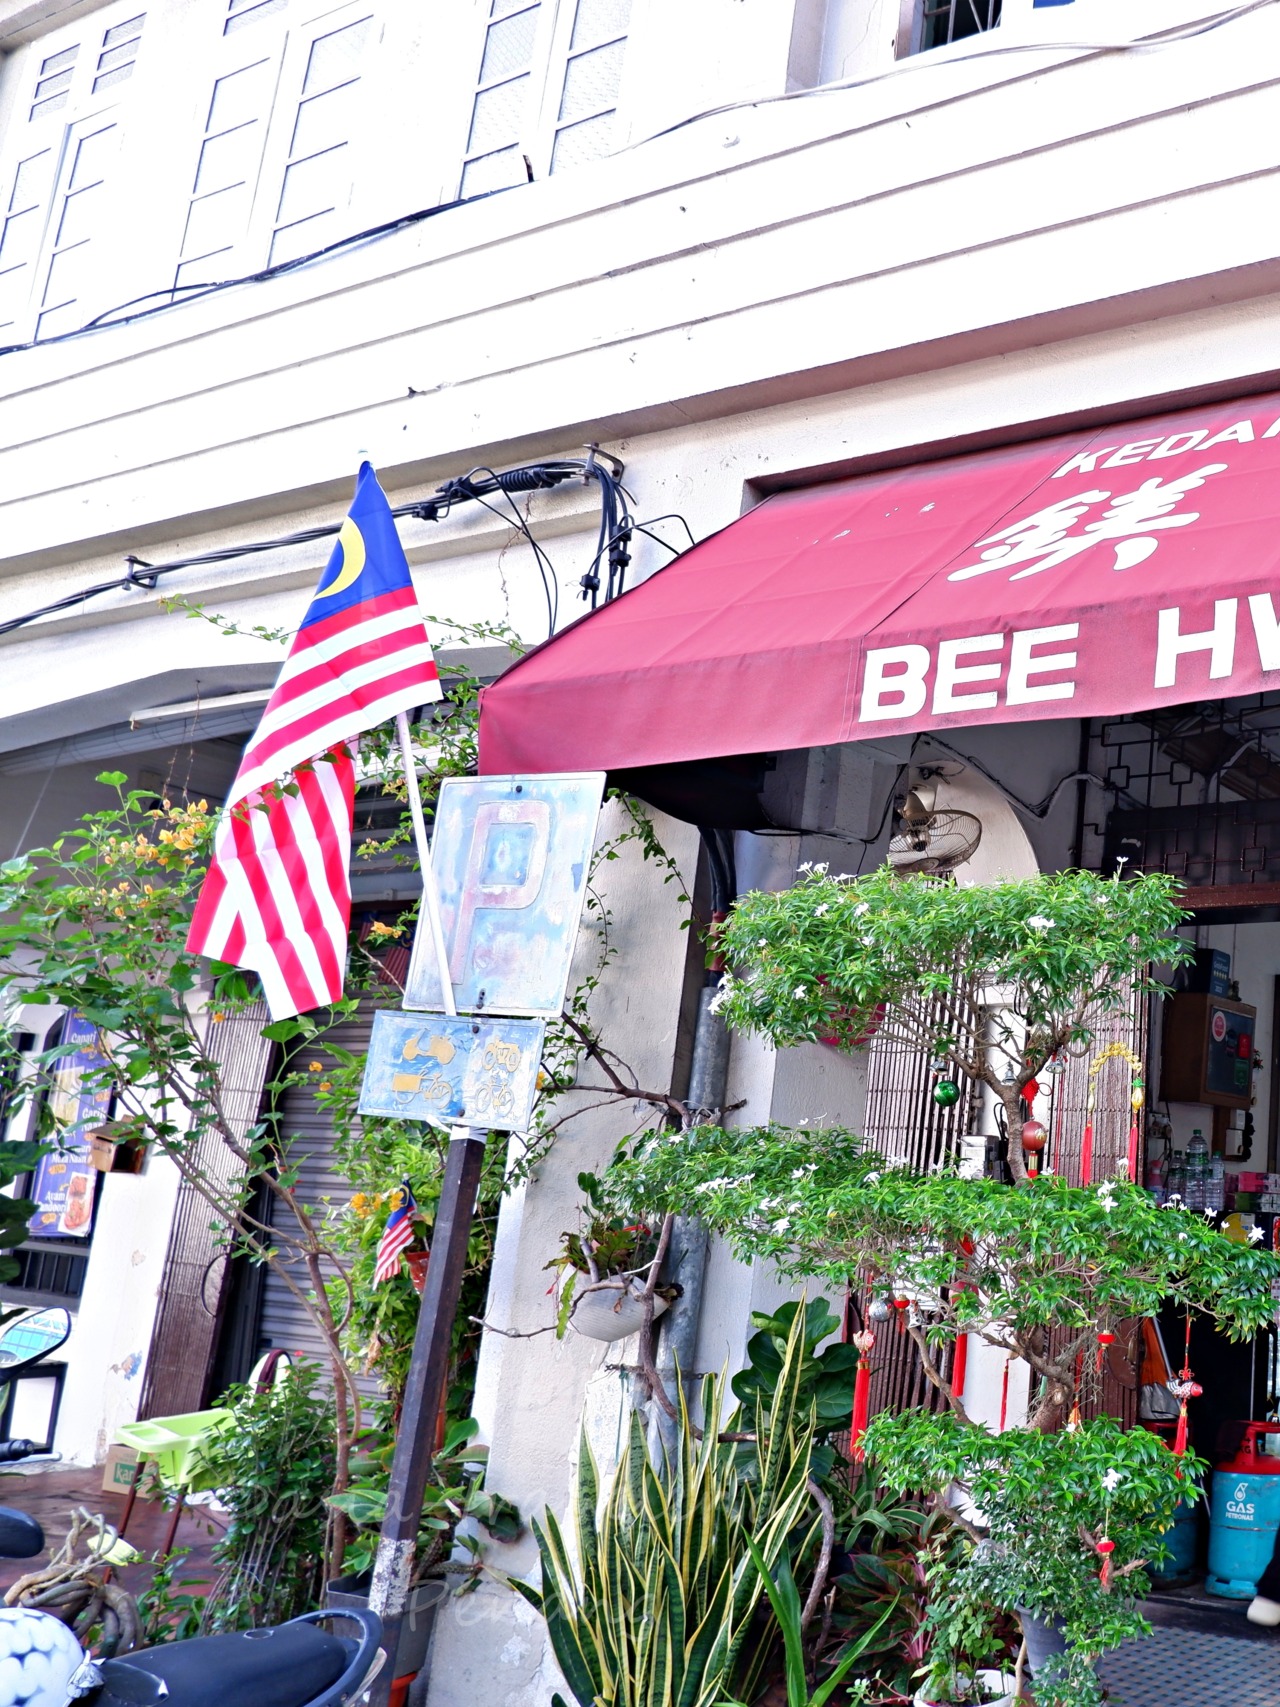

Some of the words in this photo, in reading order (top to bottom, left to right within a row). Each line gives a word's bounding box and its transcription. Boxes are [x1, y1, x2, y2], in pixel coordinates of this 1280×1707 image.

[858, 622, 1080, 724] BEE
[450, 799, 551, 986] P
[1225, 1511, 1254, 1521] PETRONAS
[1226, 1500, 1255, 1514] GAS
